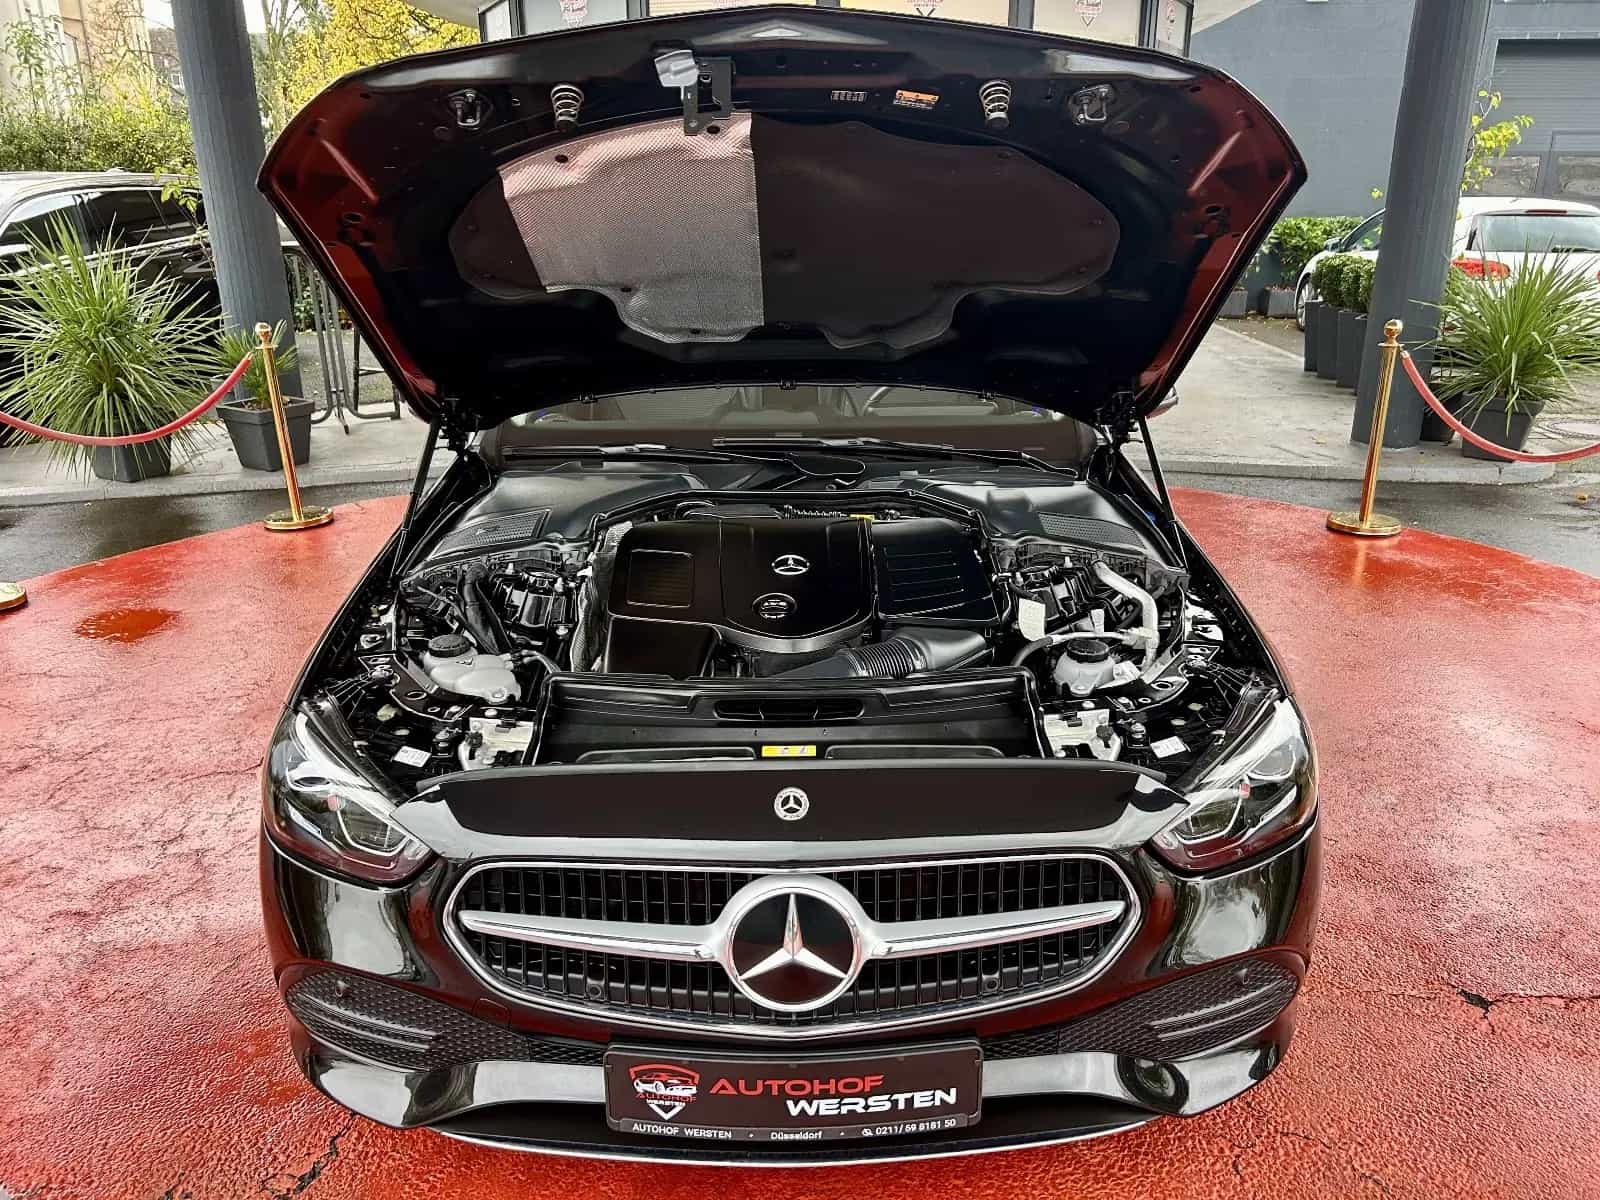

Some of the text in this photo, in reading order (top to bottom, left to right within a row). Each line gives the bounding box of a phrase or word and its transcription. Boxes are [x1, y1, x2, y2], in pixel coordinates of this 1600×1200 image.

[709, 1074, 885, 1097] AUTOHOF
[786, 1087, 957, 1117] WERSTEN
[632, 1122, 733, 1140] AUTOHOF WERSTEN
[770, 1130, 823, 1141] Düsseldorf
